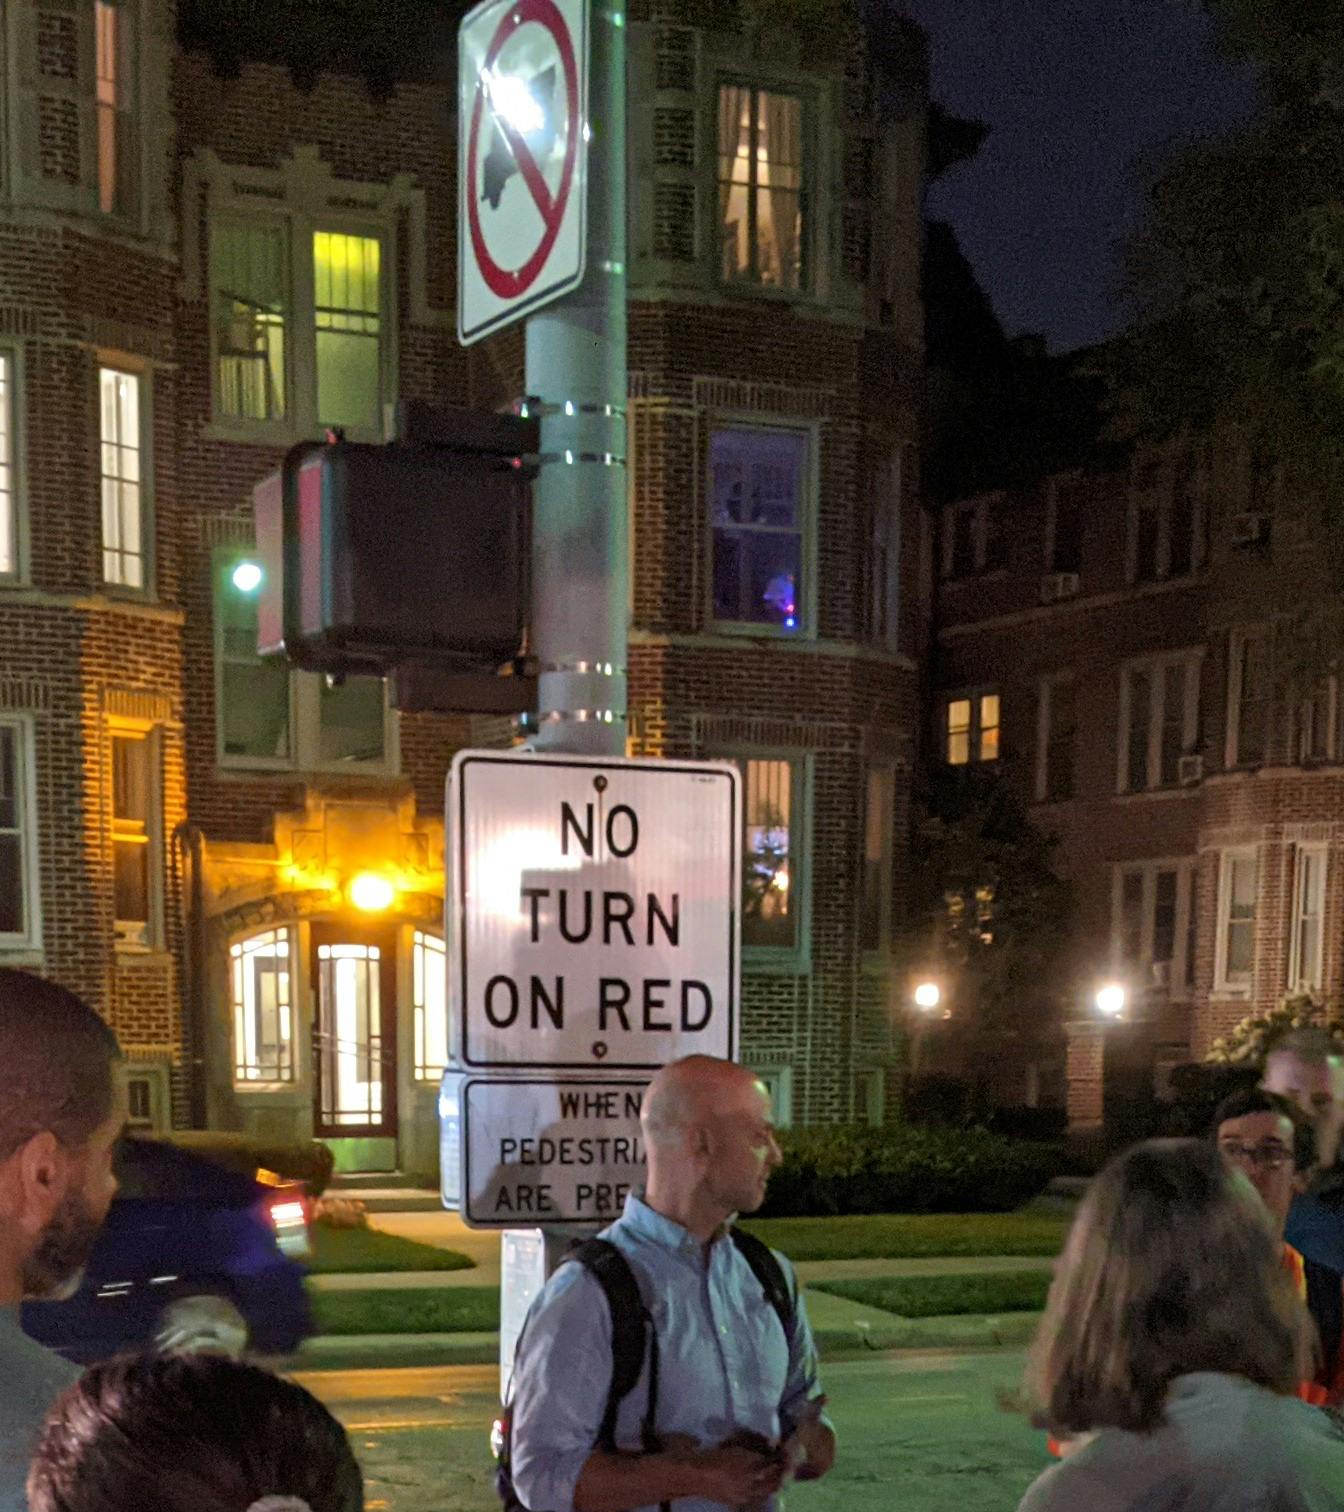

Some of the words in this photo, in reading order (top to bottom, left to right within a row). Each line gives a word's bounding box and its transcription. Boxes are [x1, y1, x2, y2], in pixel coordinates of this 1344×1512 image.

[560, 802, 638, 858] NO
[520, 888, 680, 946] TURN
[484, 975, 564, 1029] ON
[598, 978, 713, 1032] RED
[560, 1092, 641, 1119] WHEN
[501, 1137, 648, 1165] PEDESTRI
[495, 1184, 552, 1213] ARE
